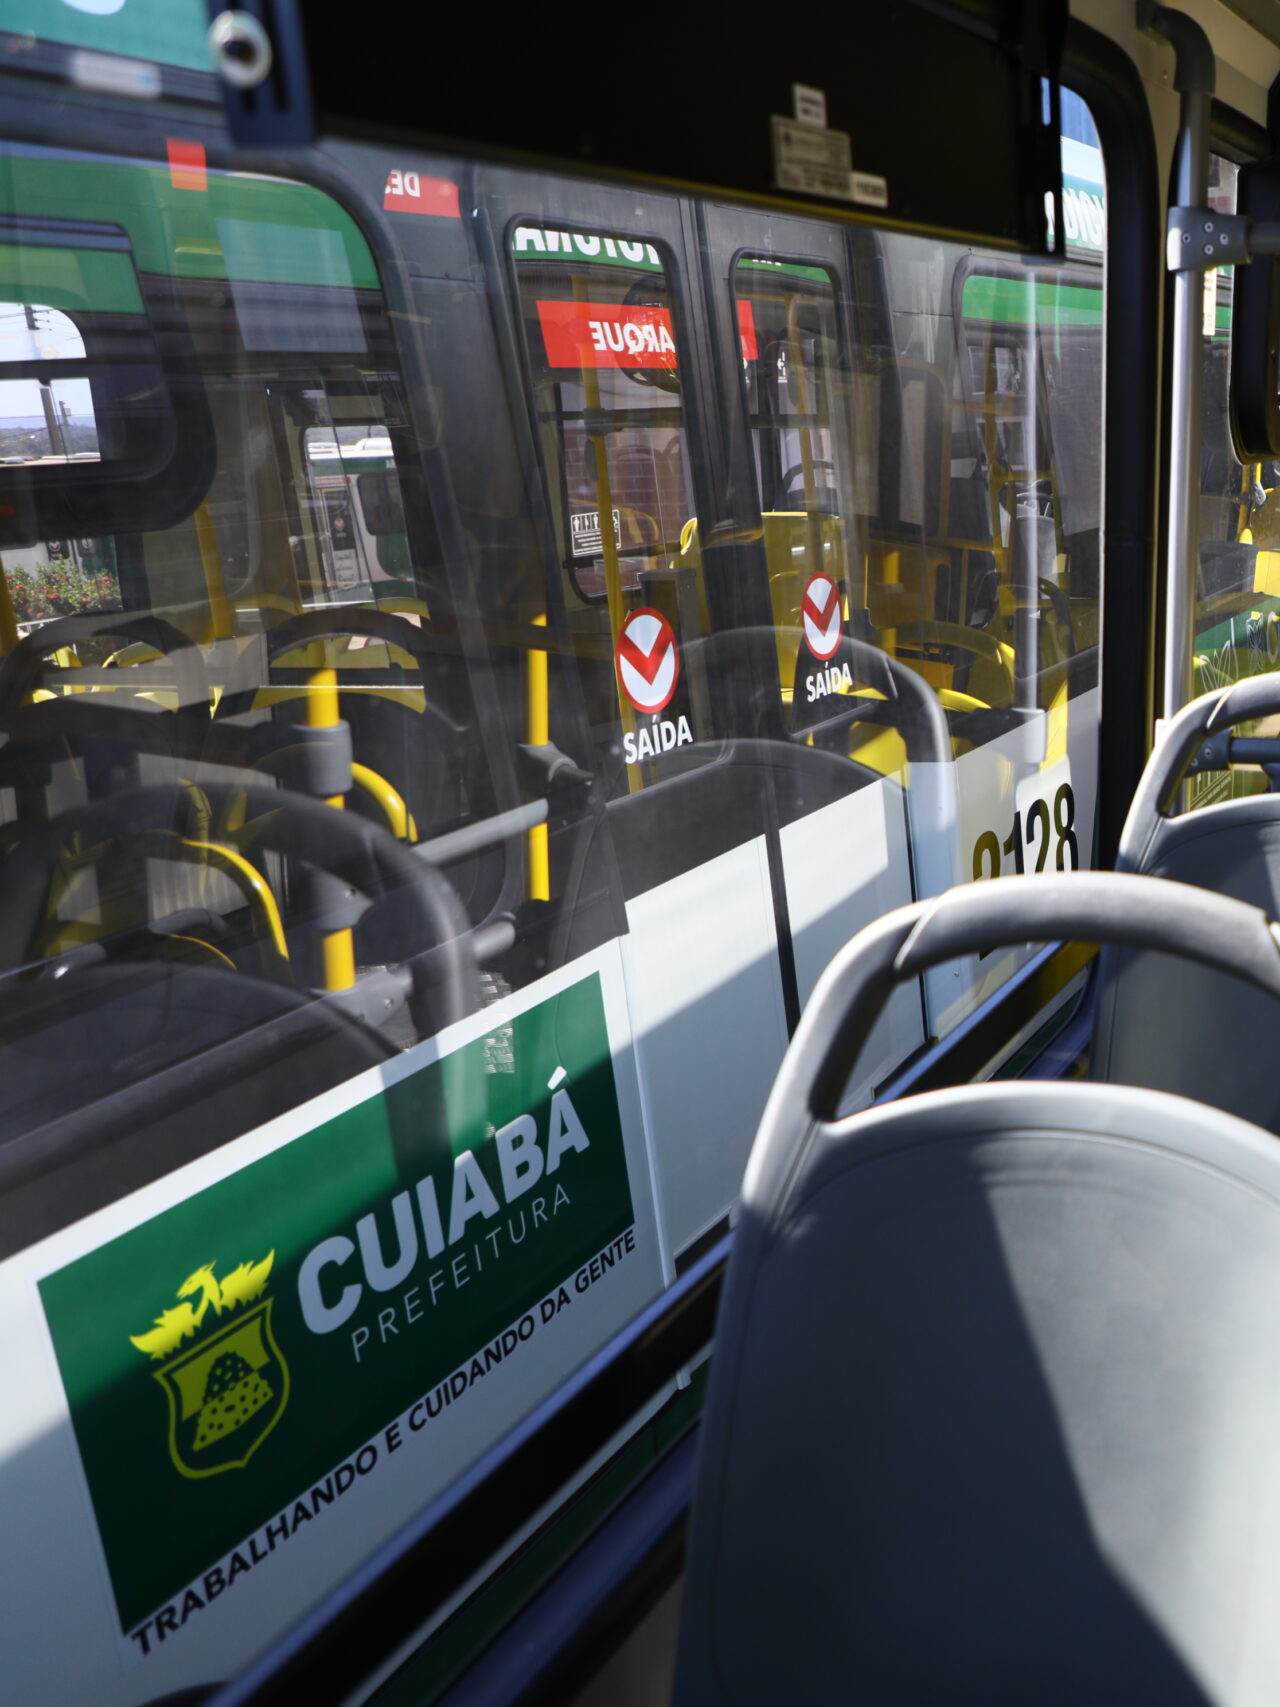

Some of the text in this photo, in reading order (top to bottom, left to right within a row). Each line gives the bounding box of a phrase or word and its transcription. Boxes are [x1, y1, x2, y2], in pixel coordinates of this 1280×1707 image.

[623, 714, 694, 765] SAÍDA
[806, 661, 853, 703] SAÍDA
[297, 1065, 591, 1335] CUIABÁ
[351, 1183, 571, 1364] PREFEITURA
[131, 1229, 636, 1656] TRABALHANDO E CUIDANDO DA GENTE
